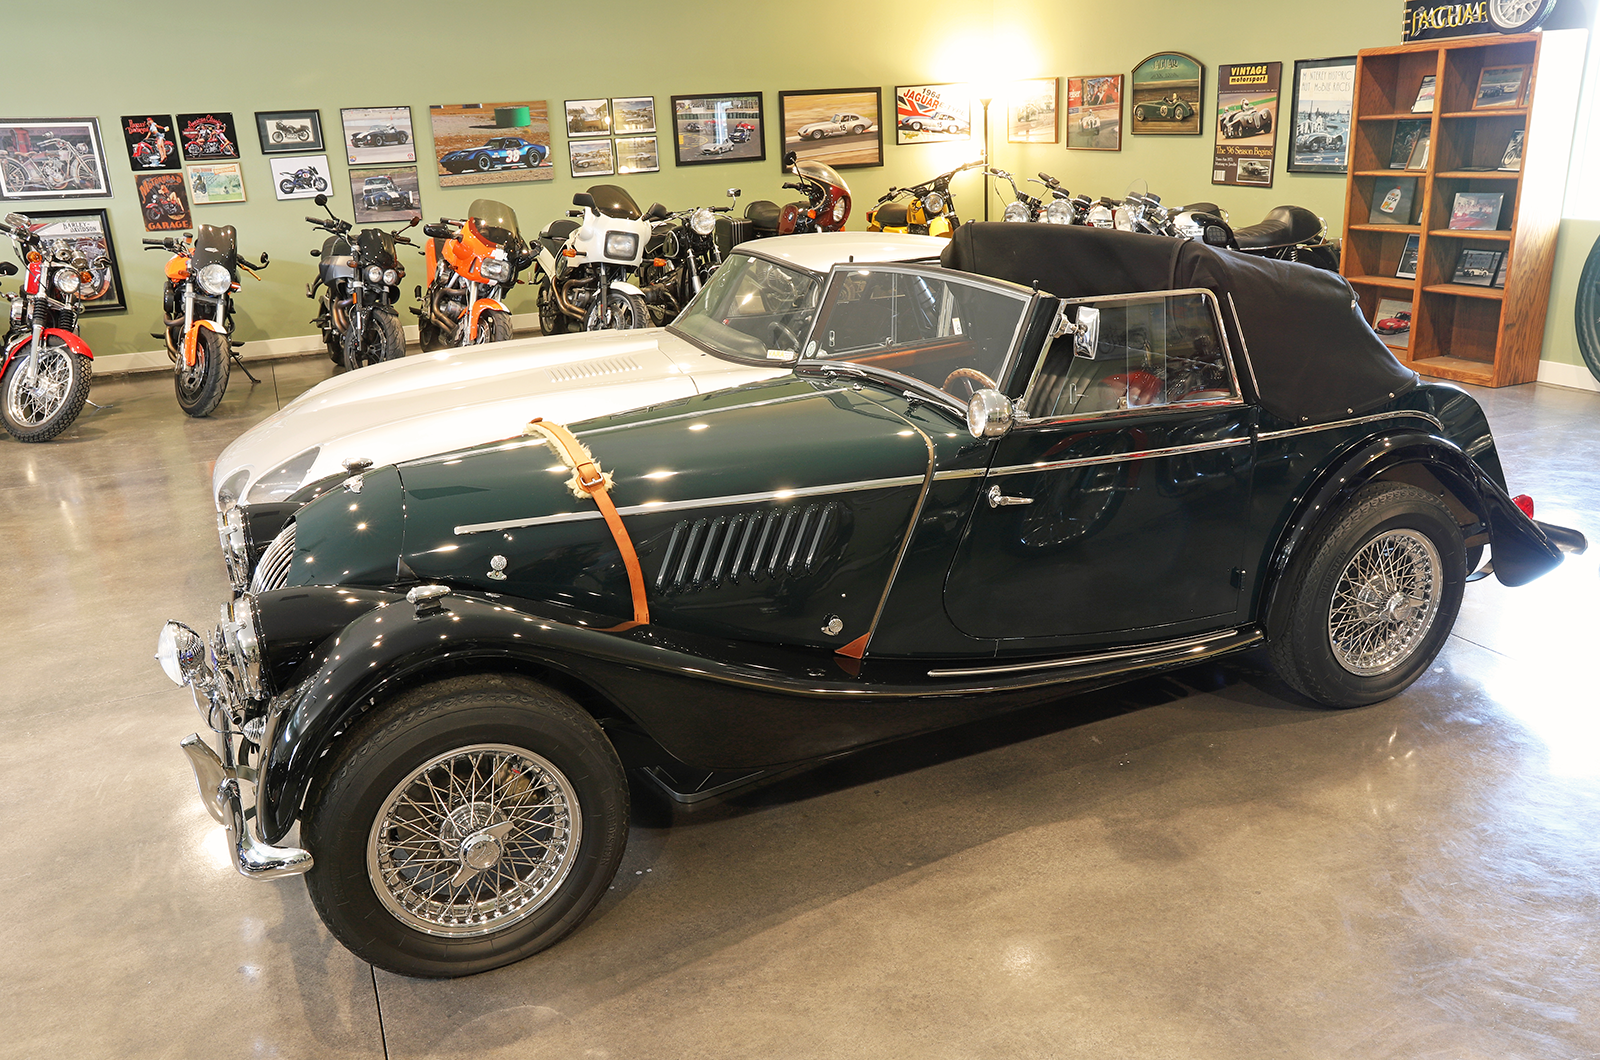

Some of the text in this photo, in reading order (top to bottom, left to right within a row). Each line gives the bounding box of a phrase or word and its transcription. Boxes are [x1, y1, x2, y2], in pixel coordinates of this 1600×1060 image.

[1231, 65, 1268, 76] VINTAGE
[1230, 76, 1266, 84] motorsport
[903, 89, 940, 109] JAGUAR
[922, 88, 941, 100] 1964
[505, 149, 521, 163] 38
[1216, 146, 1226, 155] The
[1235, 146, 1253, 155] Season
[1253, 146, 1273, 157] Begins!
[147, 220, 189, 230] GARAGE
[1319, 550, 1347, 598] VREDESTEIN
